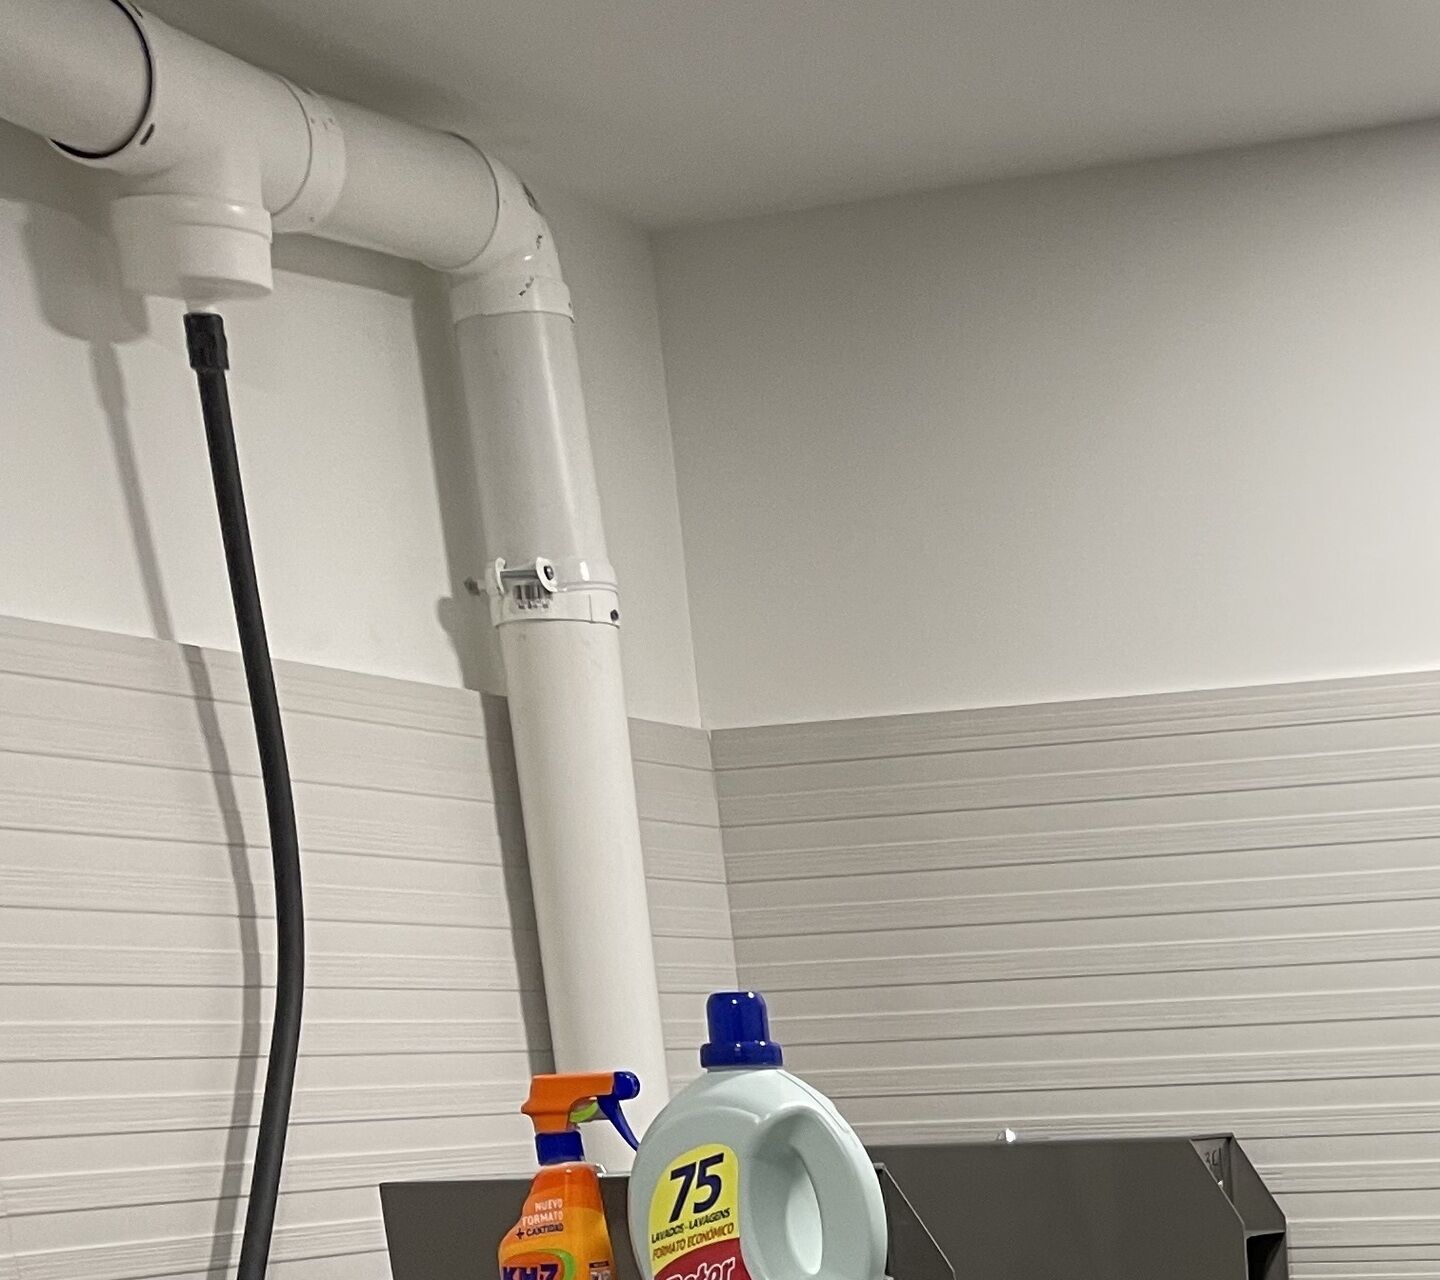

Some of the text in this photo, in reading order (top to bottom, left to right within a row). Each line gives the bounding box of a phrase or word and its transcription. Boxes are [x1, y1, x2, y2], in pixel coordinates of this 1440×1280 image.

[669, 1153, 724, 1223] 75
[534, 1198, 563, 1212] NUEVO
[522, 1210, 564, 1228] FORMATO
[651, 1222, 685, 1243] LAVADOS
[689, 1208, 731, 1230] LAVAGENS
[526, 1223, 564, 1236] CANTIDAD
[653, 1239, 686, 1260] FORMATO
